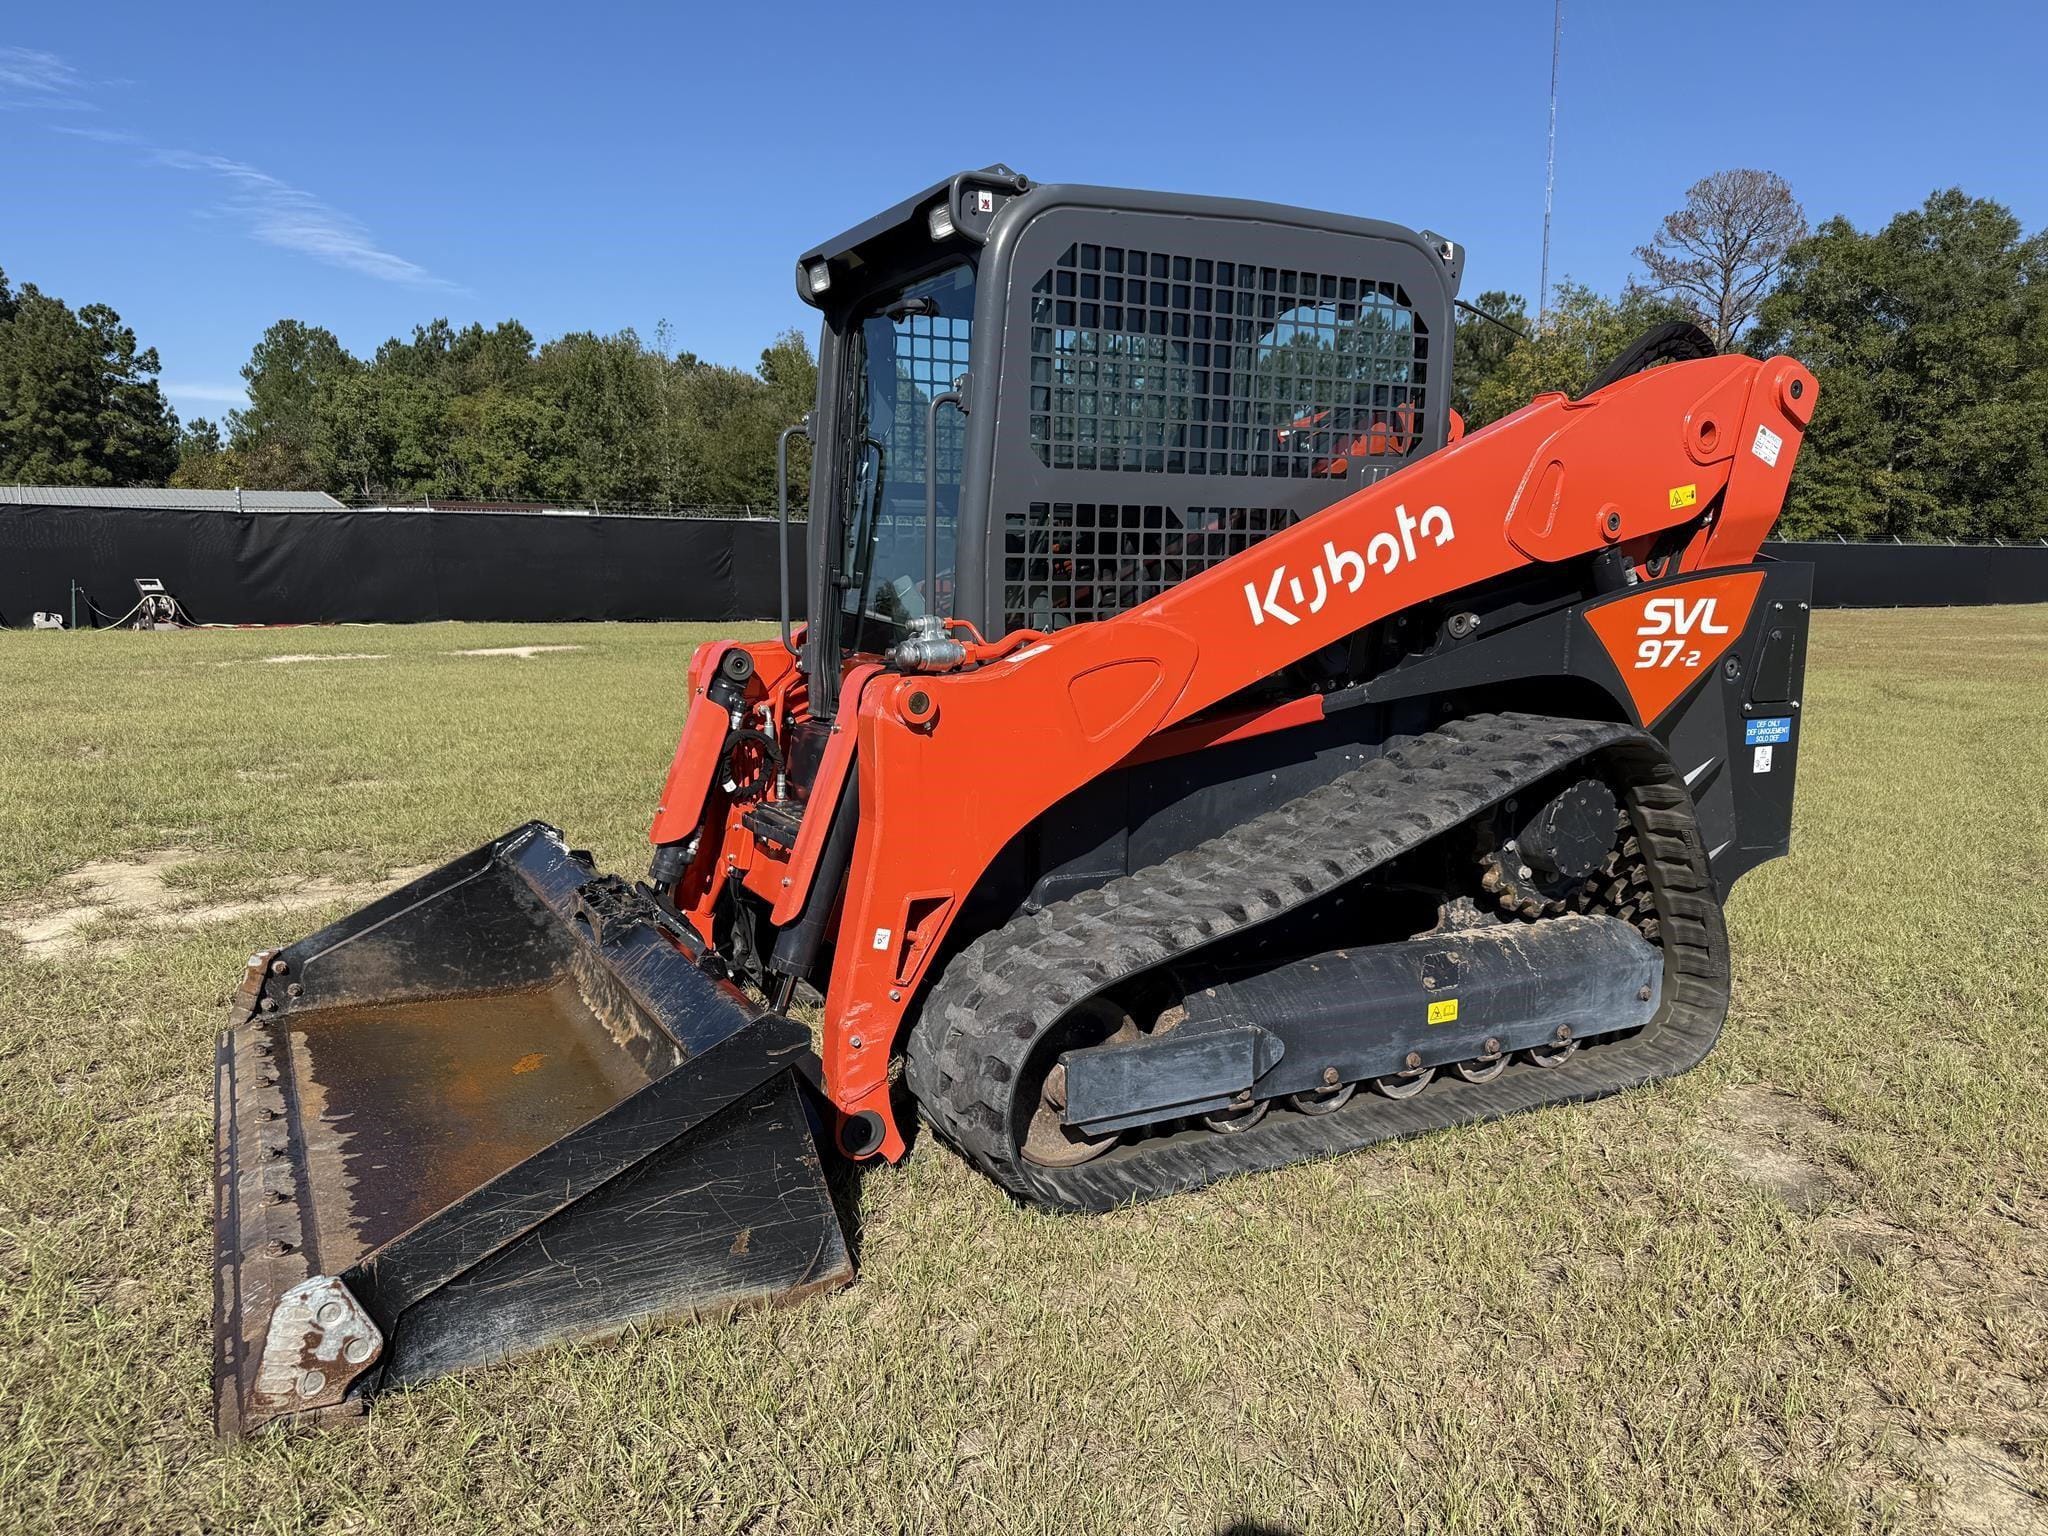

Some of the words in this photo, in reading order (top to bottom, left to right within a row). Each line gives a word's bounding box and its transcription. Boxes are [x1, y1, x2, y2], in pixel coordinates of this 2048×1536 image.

[1244, 504, 1455, 626] Kubota
[1637, 598, 1728, 636] SVL
[1634, 640, 1701, 669] 97-2
[1758, 727, 1789, 735] UNIQUEMENT
